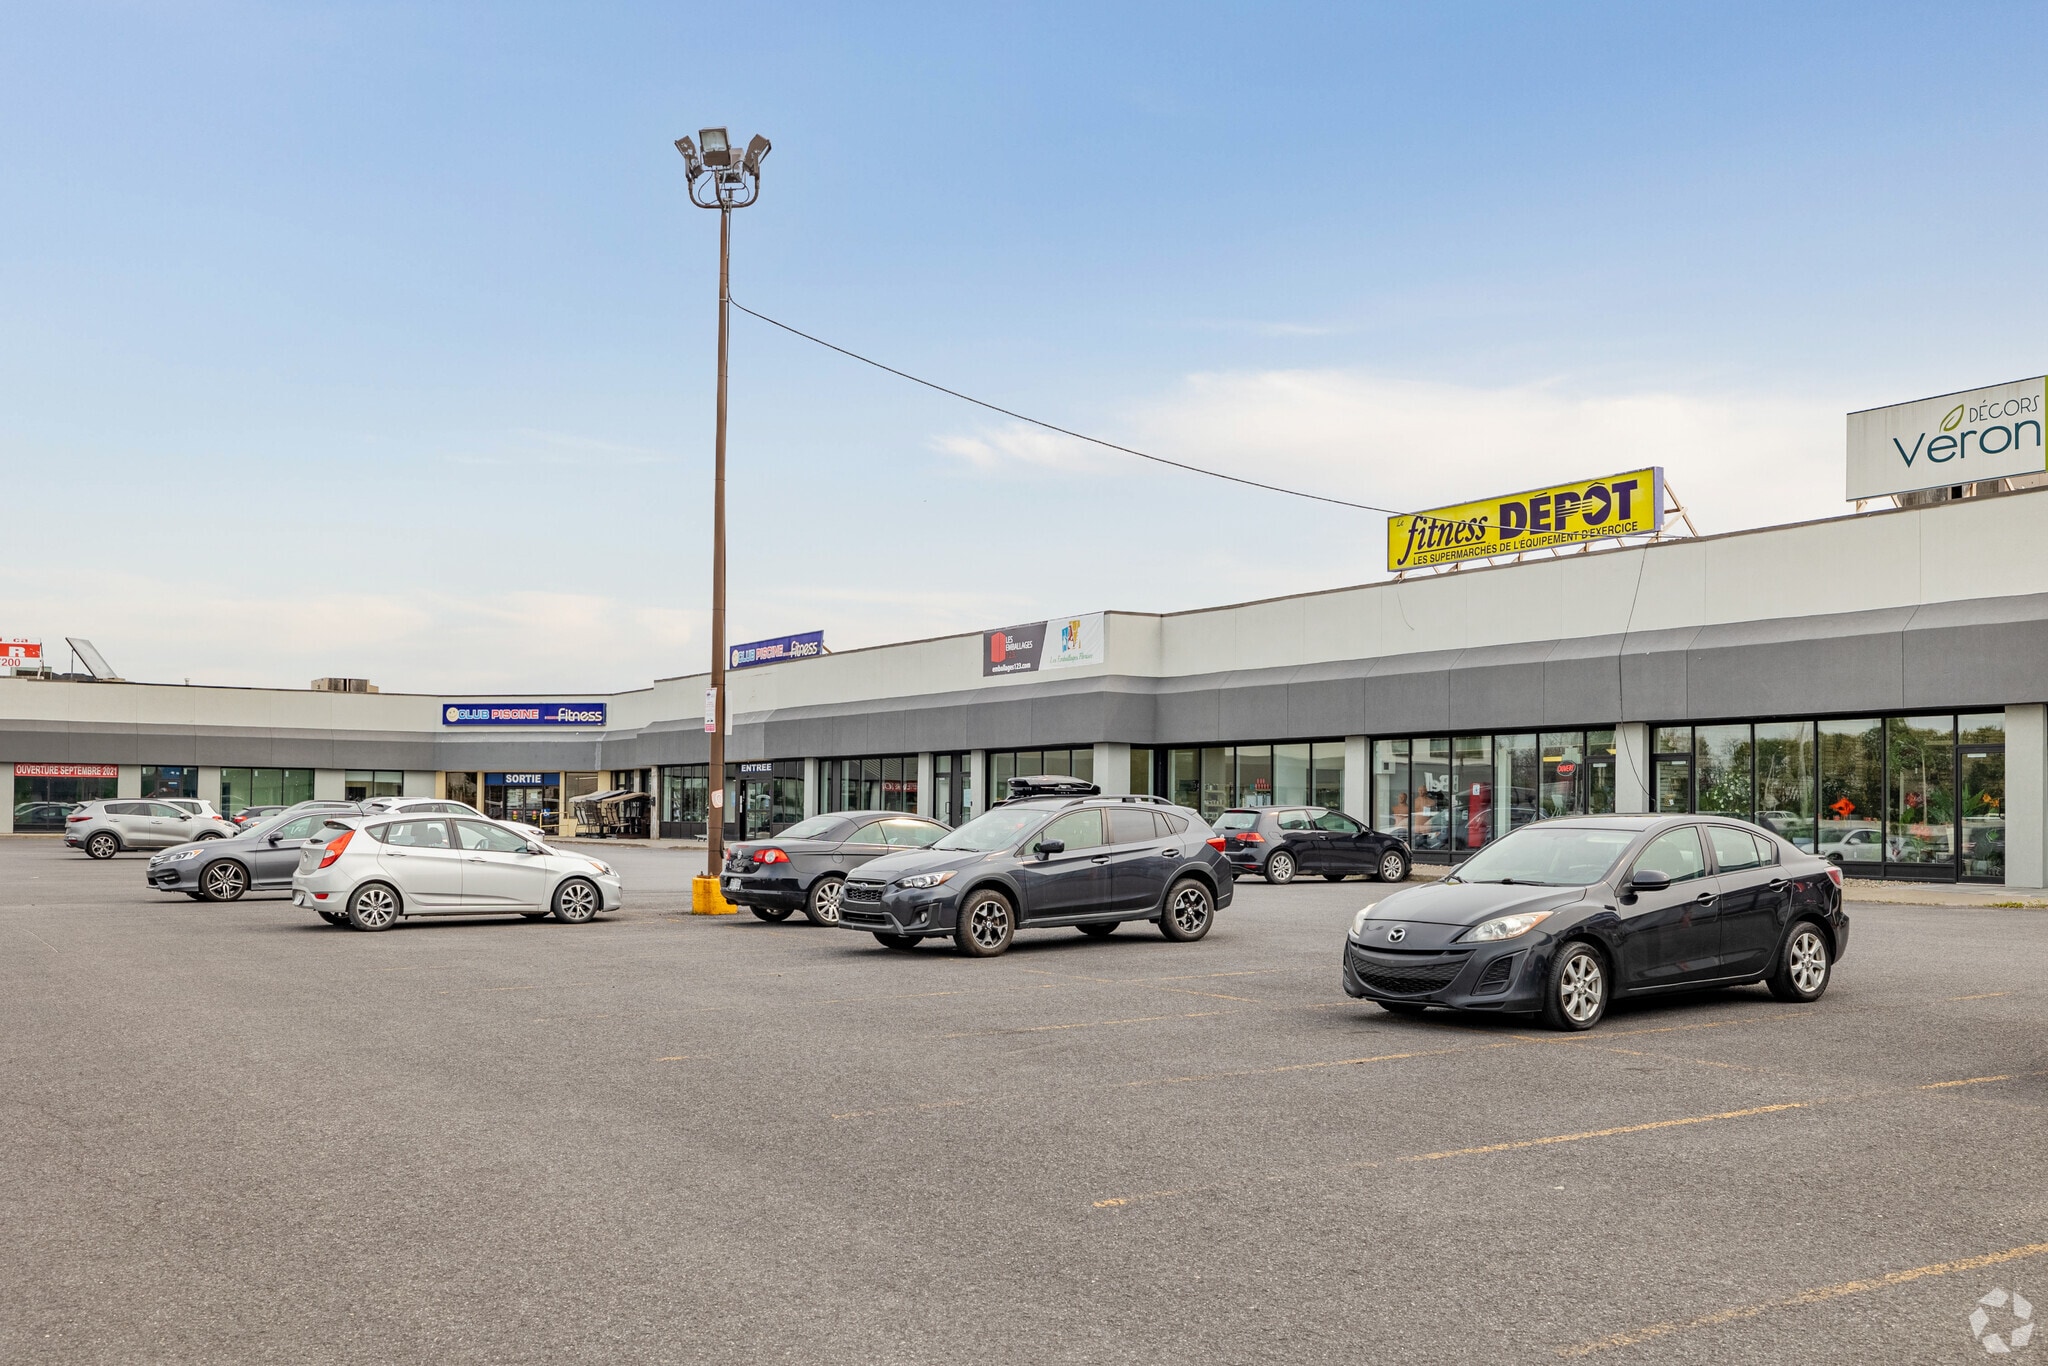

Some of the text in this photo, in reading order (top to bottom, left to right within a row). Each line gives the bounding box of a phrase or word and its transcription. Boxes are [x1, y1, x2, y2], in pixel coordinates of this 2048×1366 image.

[1969, 395, 2040, 423] DÉCORS
[1396, 479, 1638, 566] fitness DÉPÔT
[1413, 521, 1638, 566] LES SUPERMARCHÉS DE L'ÉQUIPEMENT D'EXERCICE
[1005, 635, 1014, 644] LES
[1005, 640, 1033, 651] EMBALLAGES
[738, 648, 755, 664] CLUB
[755, 644, 784, 661] PISCINE
[0, 658, 21, 667] 200
[458, 709, 490, 719] CLUB
[491, 709, 540, 719] PISCINE
[16, 764, 118, 776] OUVERTURE SEPTEMBRE 2021
[741, 763, 772, 772] ENTREE
[505, 774, 541, 784] SORTIE
